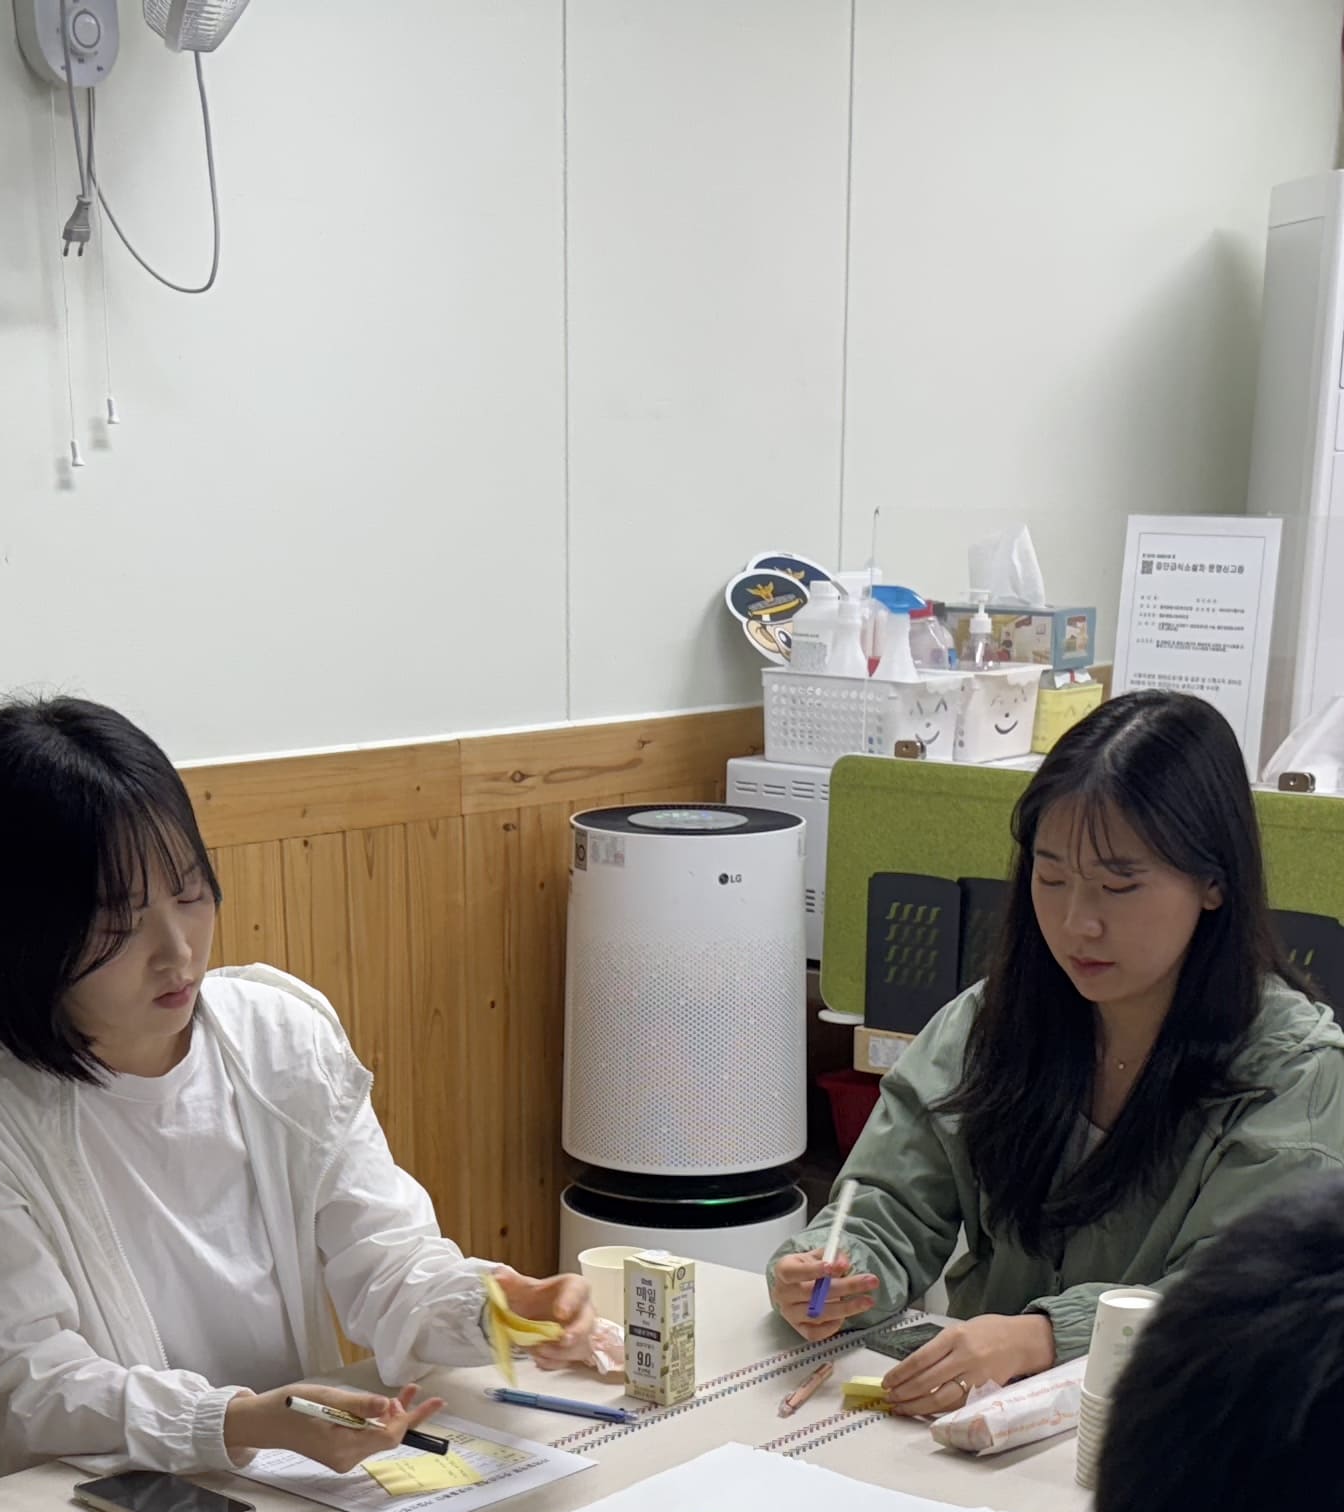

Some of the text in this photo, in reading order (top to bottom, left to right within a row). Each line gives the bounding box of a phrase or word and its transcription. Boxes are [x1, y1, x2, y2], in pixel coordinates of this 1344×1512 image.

[730, 874, 742, 883] LG
[636, 1286, 656, 1304] 매일
[636, 1301, 656, 1319] 두유
